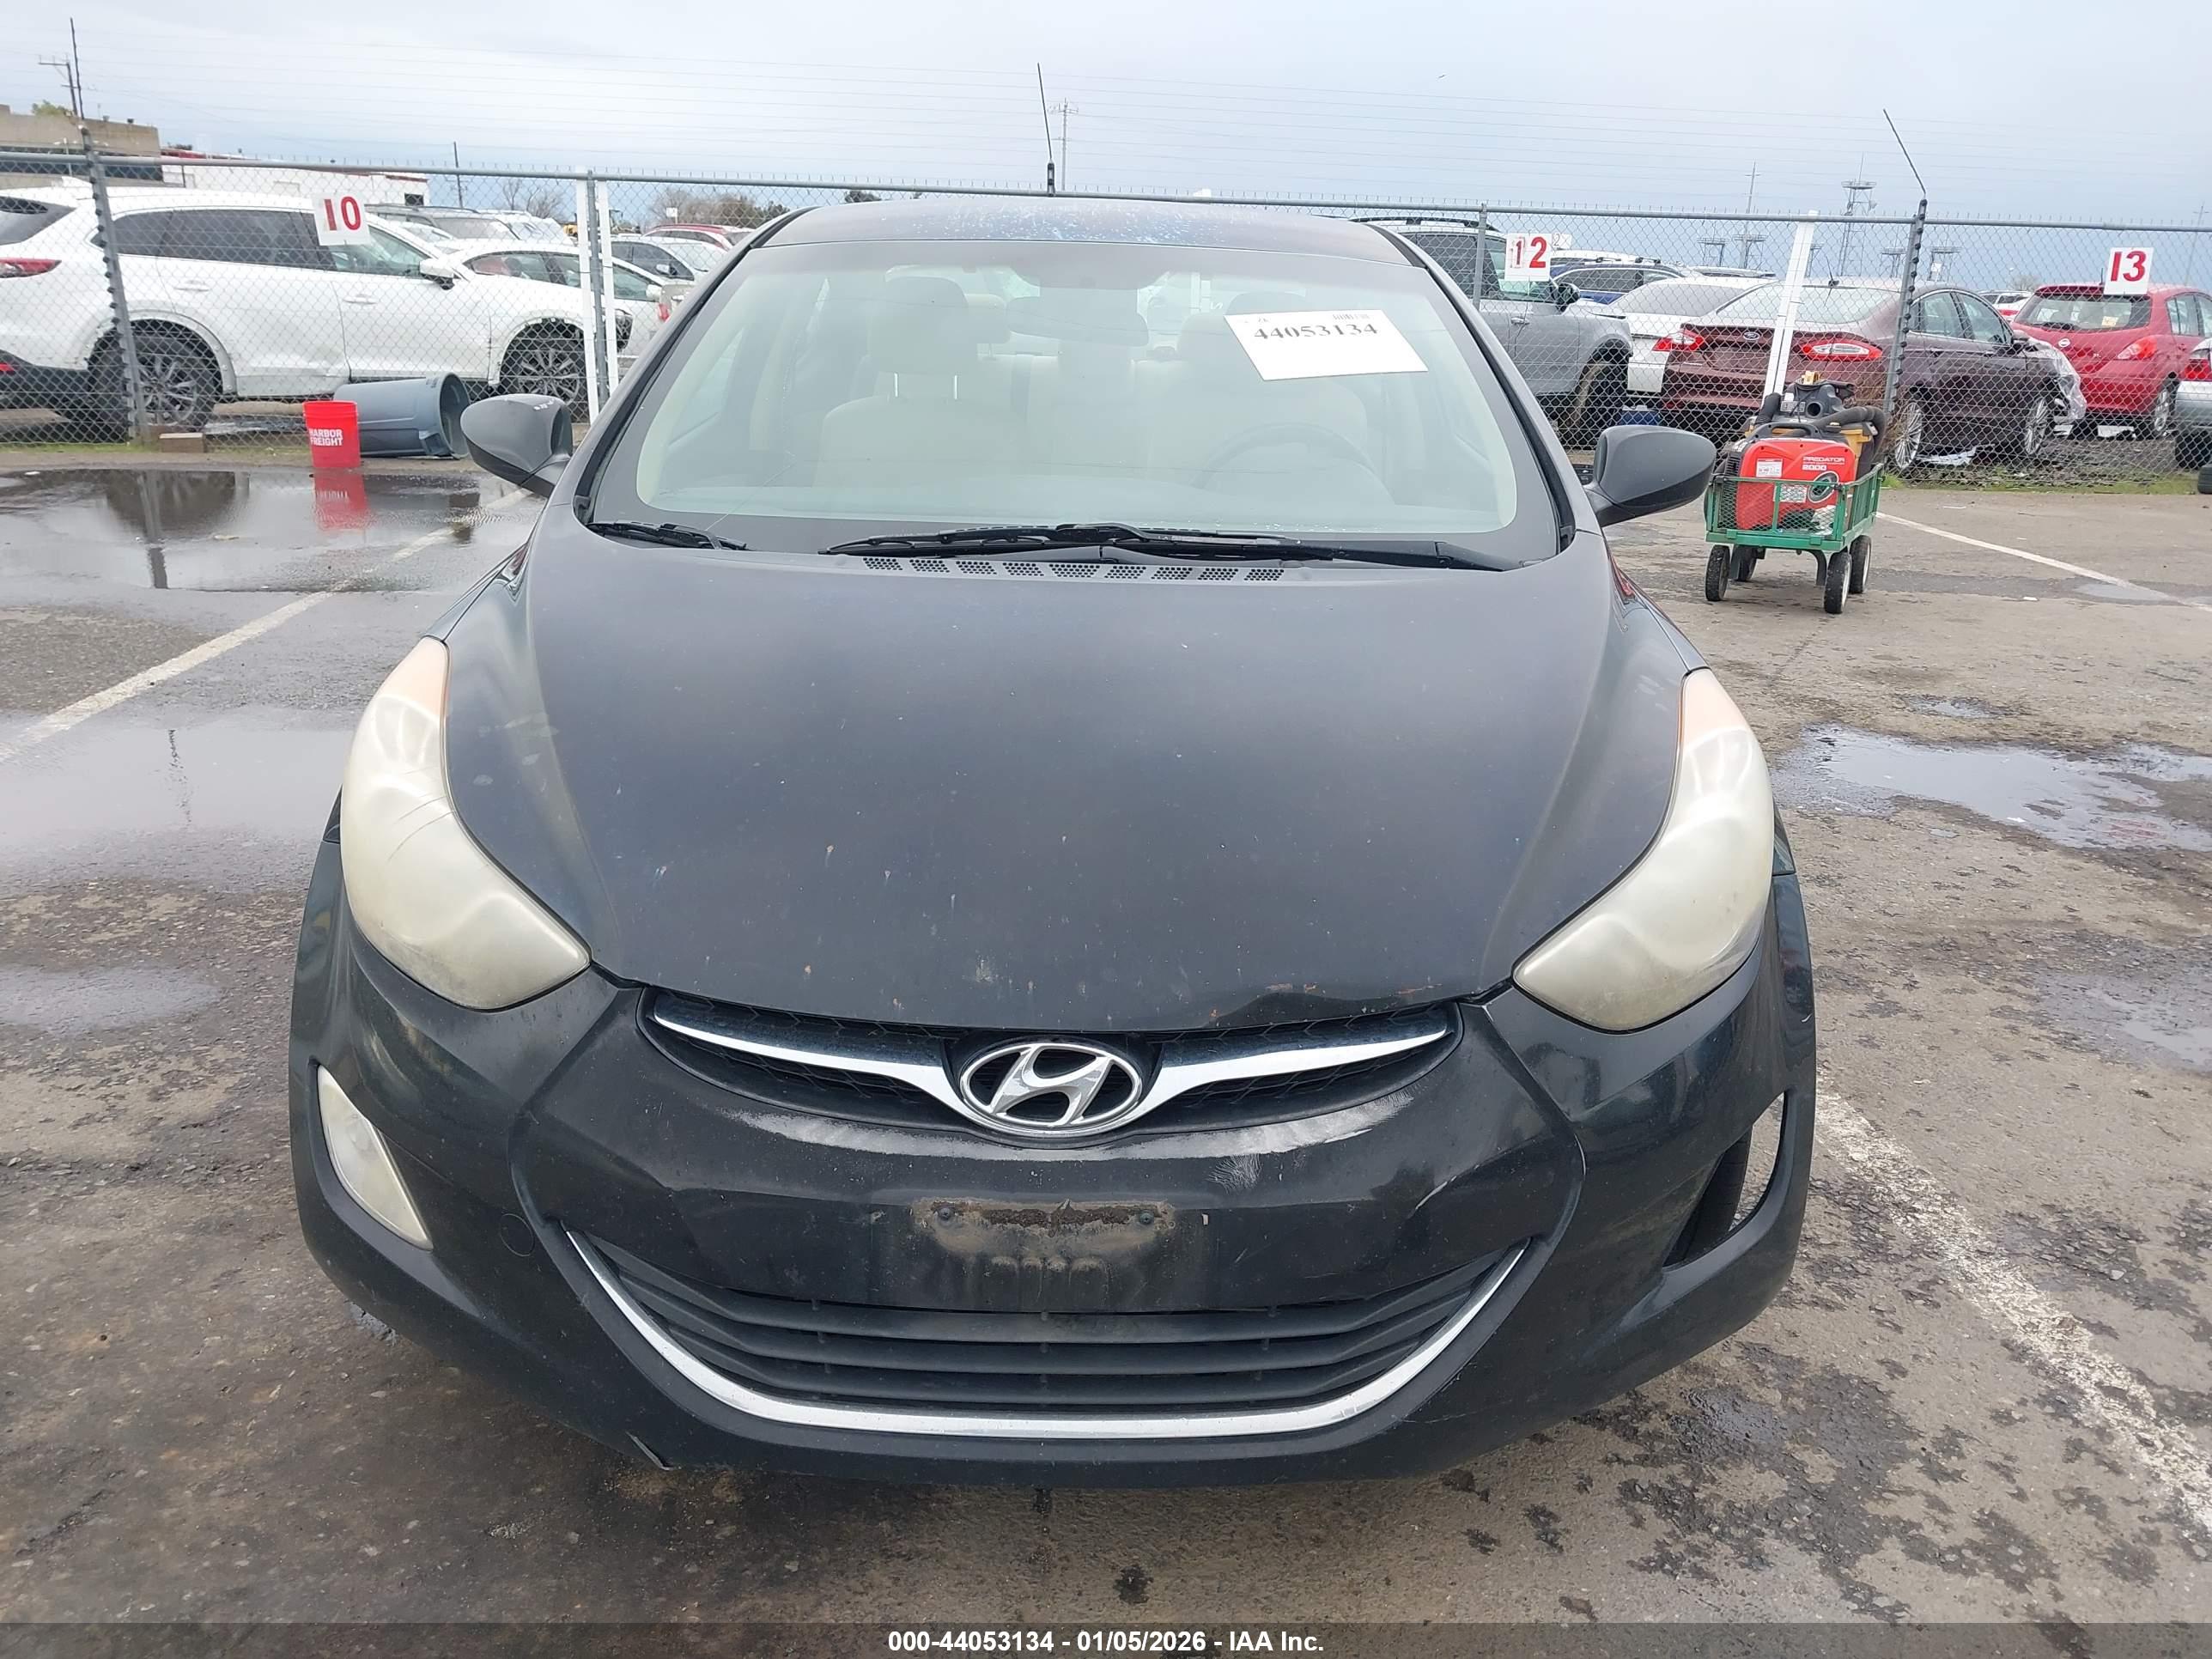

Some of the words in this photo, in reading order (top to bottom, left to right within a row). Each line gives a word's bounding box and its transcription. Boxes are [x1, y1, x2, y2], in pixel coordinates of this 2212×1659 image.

[324, 196, 361, 231] 10
[1516, 236, 1547, 269] 12
[2110, 250, 2147, 282] 13
[1254, 323, 1378, 339] 44053134
[309, 428, 342, 437] HARBOR
[310, 437, 343, 446] FREIGHT
